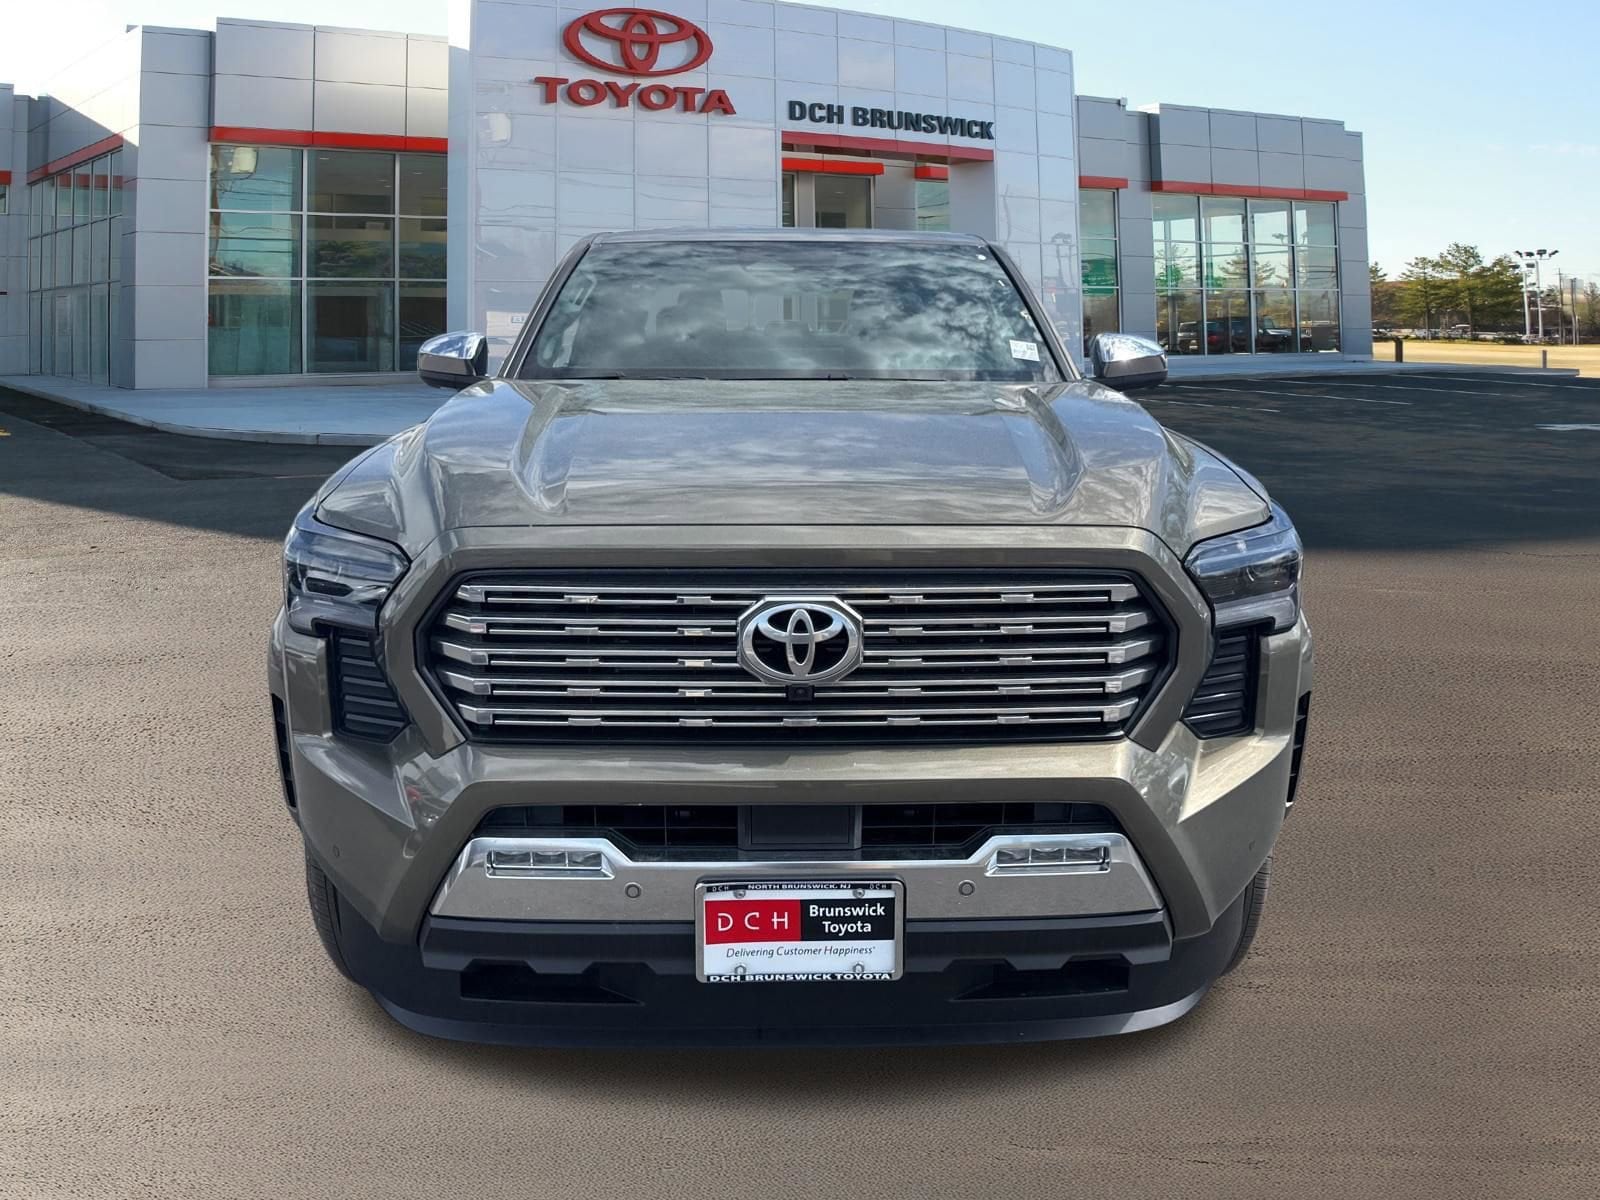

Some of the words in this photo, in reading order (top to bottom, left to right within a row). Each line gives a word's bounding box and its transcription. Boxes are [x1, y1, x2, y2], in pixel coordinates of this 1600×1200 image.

[534, 76, 736, 115] TOYOTA
[788, 100, 844, 124] DCH
[852, 106, 995, 140] BRUNSWICK
[809, 902, 885, 917] Brunswick
[717, 911, 789, 931] DCH
[822, 920, 872, 936] Toyota
[726, 947, 774, 958] Delivering
[776, 946, 821, 956] Customer
[823, 945, 873, 957] Happiness
[745, 973, 832, 981] BRUNSWICK
[834, 973, 891, 981] TOYOTA
